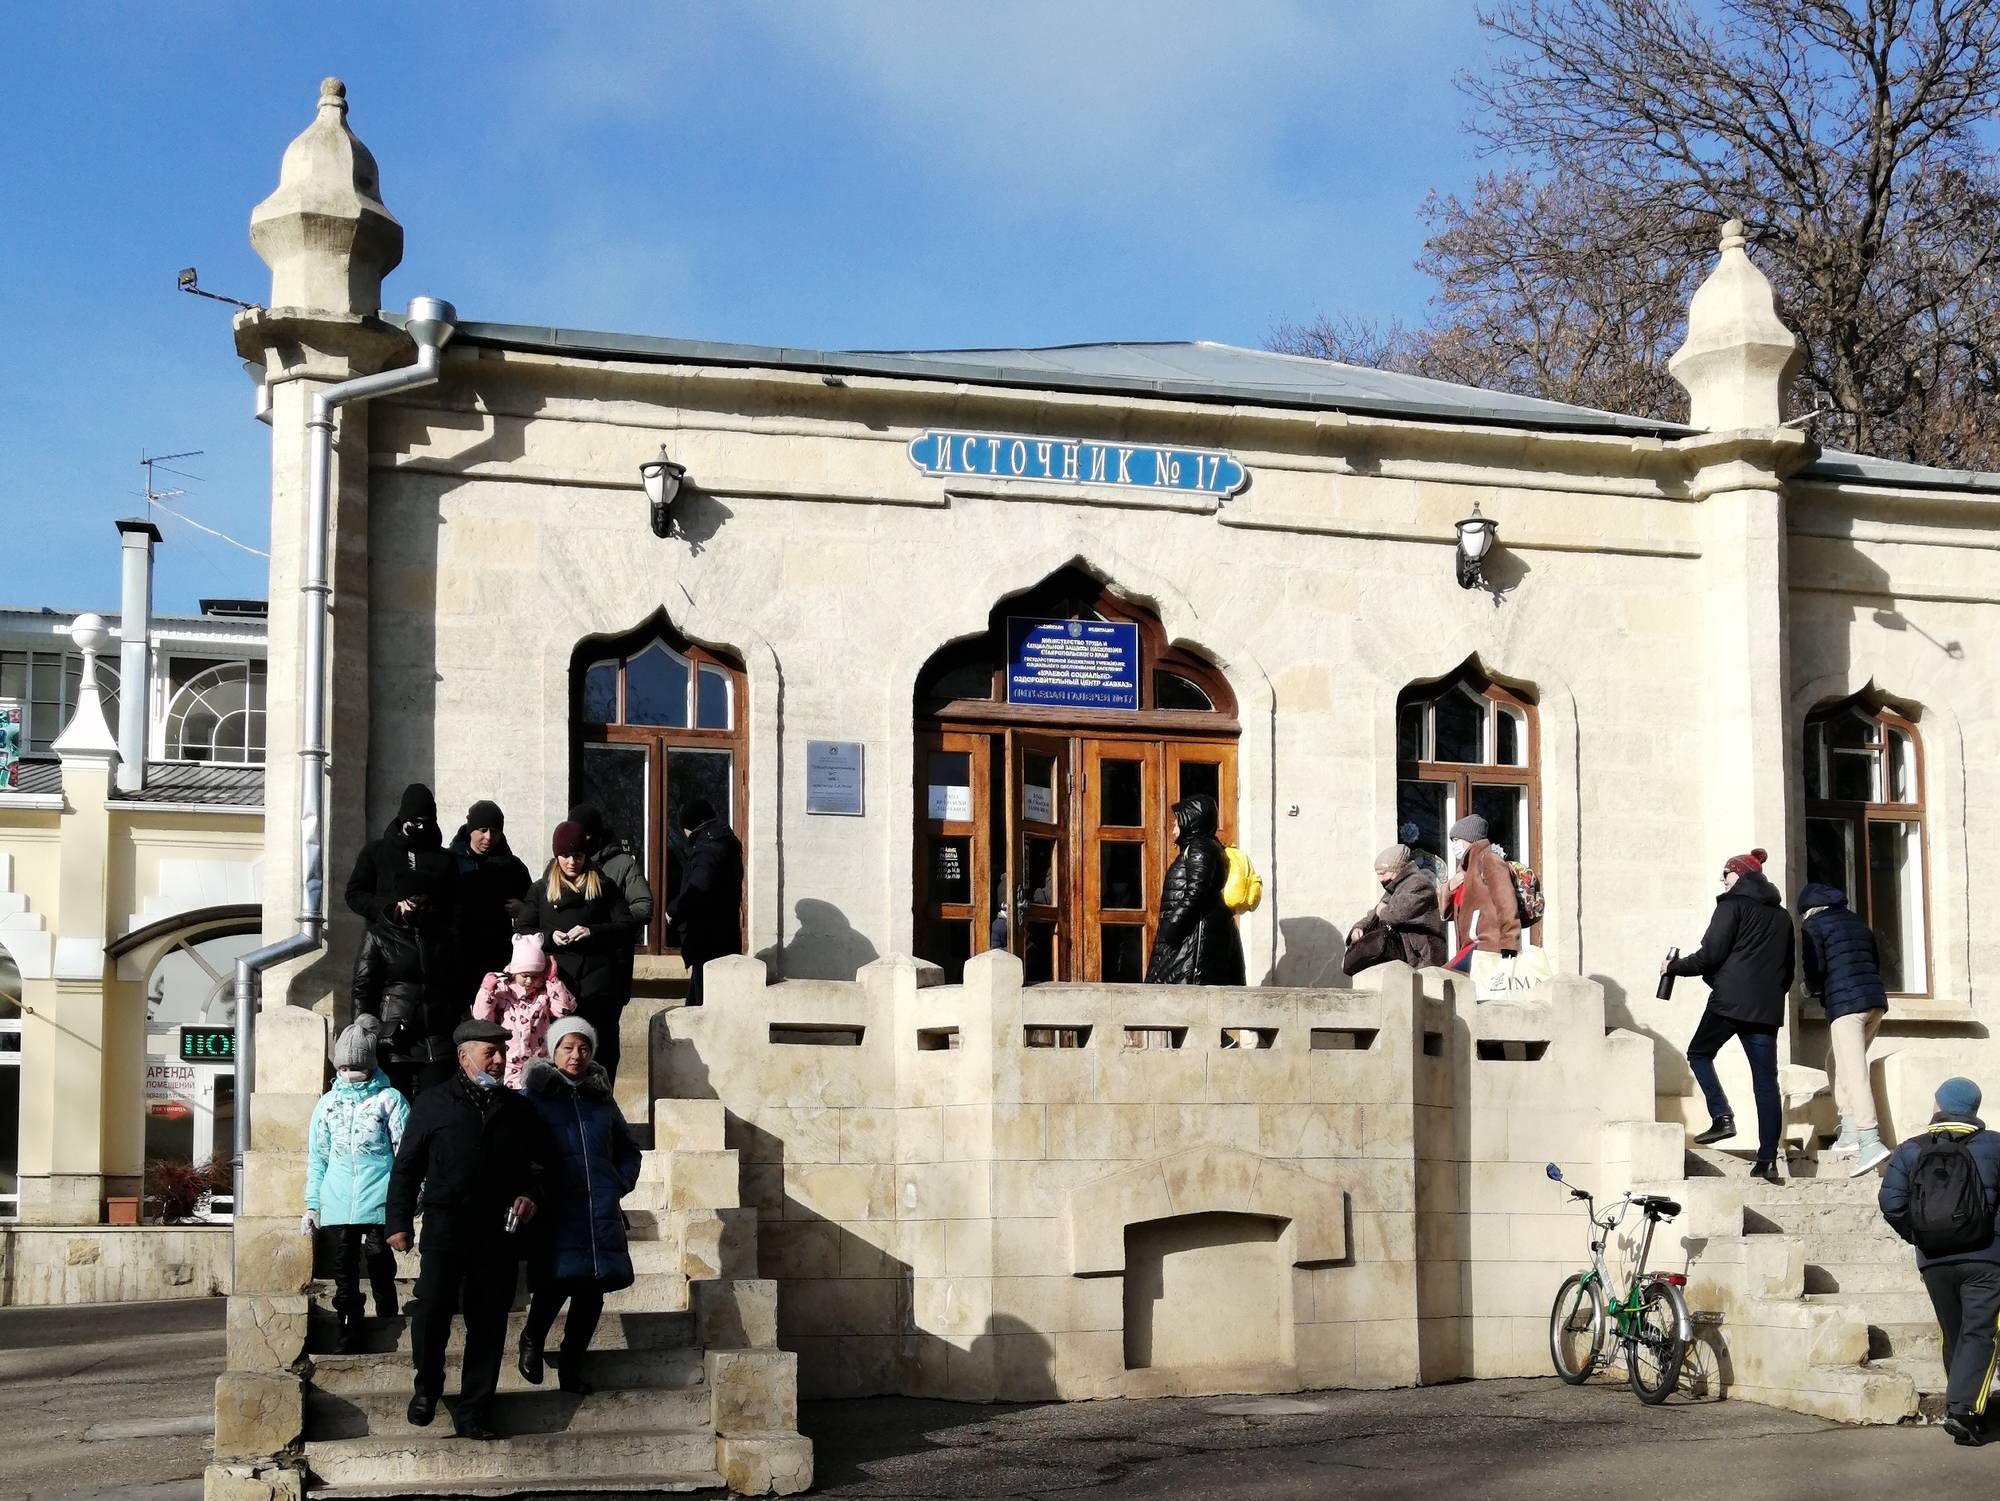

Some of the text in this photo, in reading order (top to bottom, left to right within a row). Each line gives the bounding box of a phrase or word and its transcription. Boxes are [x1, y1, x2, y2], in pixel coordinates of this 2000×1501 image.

[936, 435, 1219, 490] ИСТОЧНИК № 17
[1080, 679, 1101, 687] ЦЕНТР
[147, 1066, 195, 1079] АРЕНДА
[146, 1080, 195, 1090] ПОМЕЩЕНИЙ
